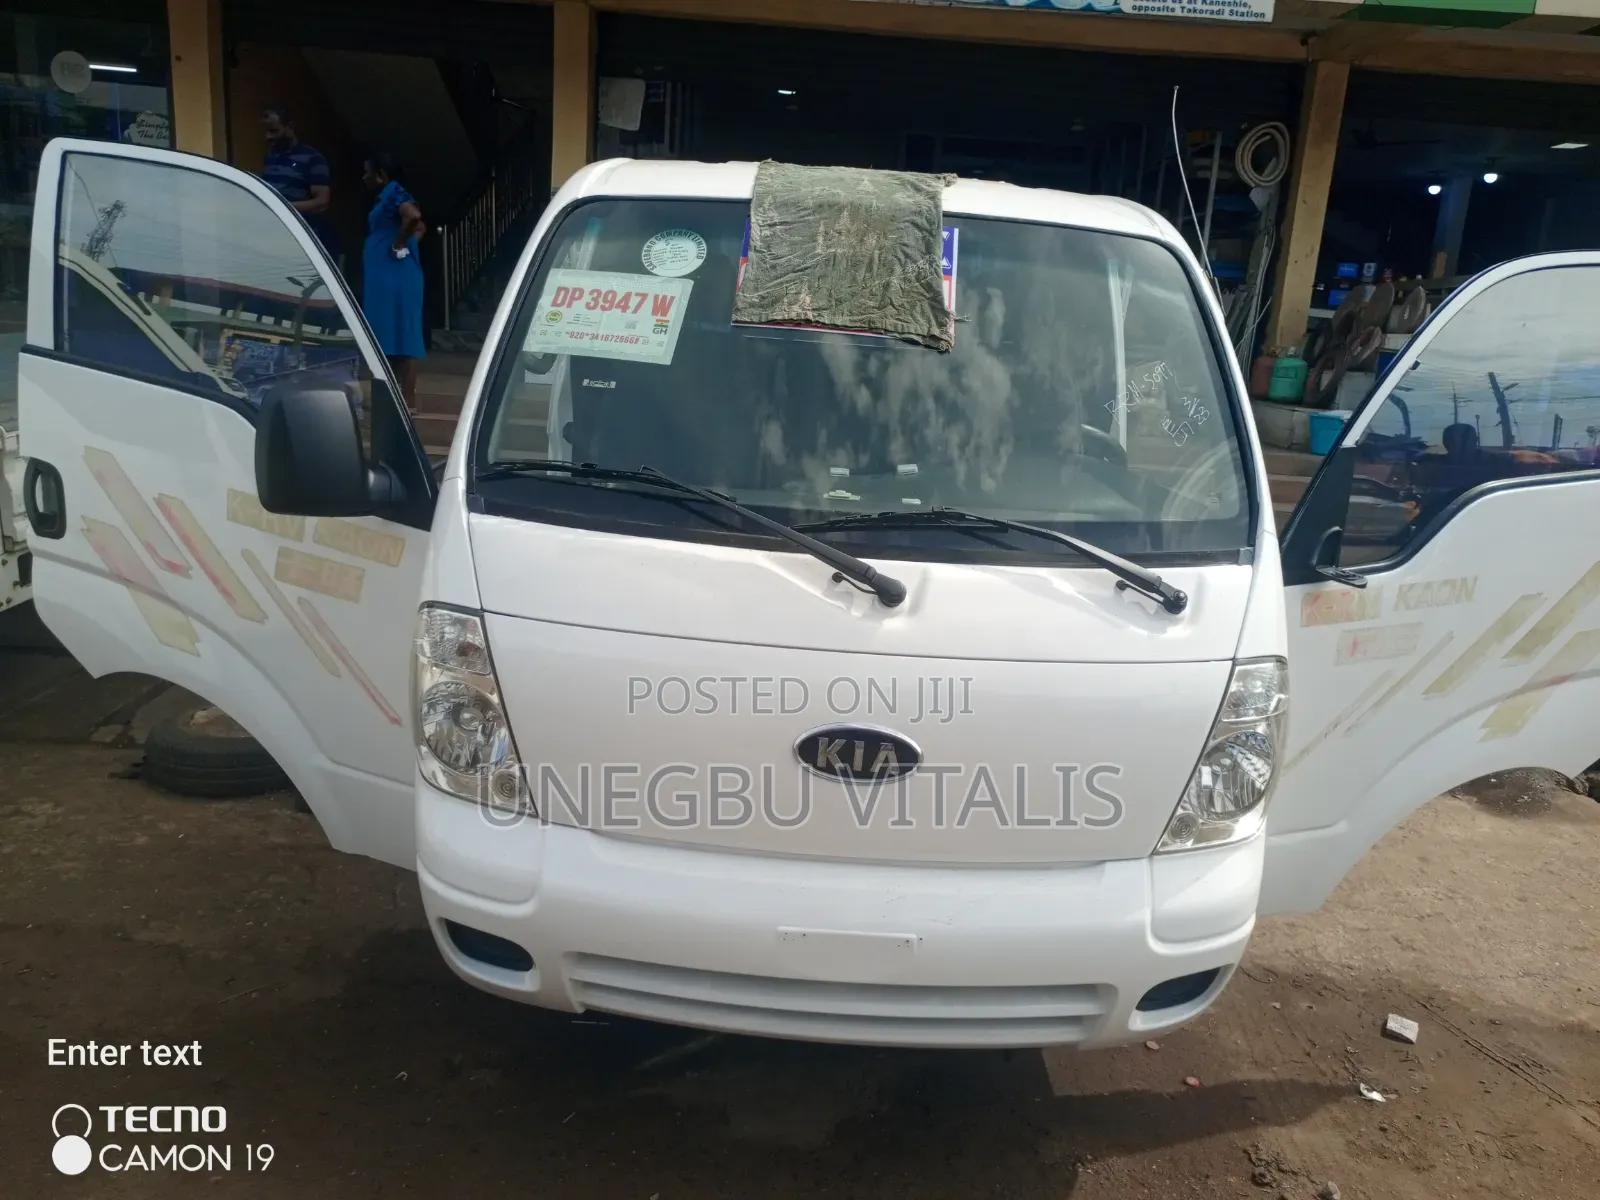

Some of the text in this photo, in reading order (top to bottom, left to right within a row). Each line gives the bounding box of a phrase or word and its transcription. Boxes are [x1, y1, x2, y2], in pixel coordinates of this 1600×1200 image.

[1132, 4, 1266, 18] opposite Takoradi Station
[655, 229, 693, 242] COMPANY
[551, 286, 676, 318] DP 3947 W
[652, 327, 668, 335] GH
[816, 736, 901, 774] KIA
